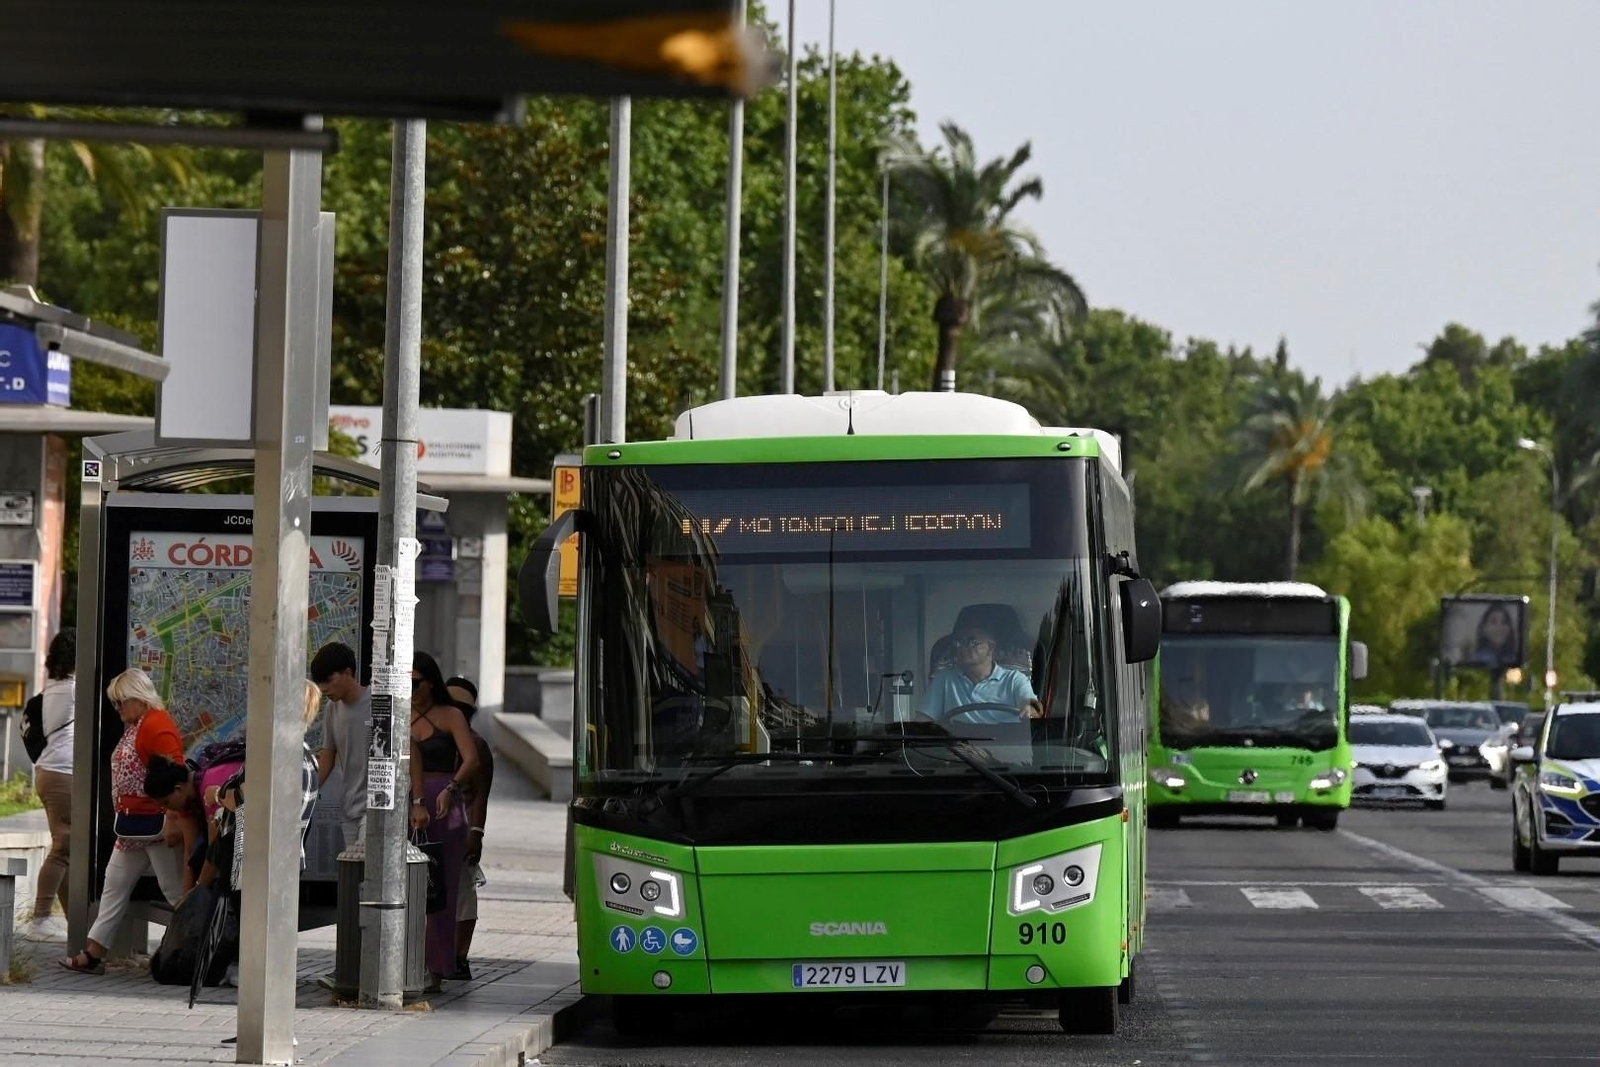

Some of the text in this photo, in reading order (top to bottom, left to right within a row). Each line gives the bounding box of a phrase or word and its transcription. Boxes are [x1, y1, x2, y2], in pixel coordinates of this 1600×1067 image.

[168, 537, 324, 569] CÓRDA
[809, 922, 888, 936] SCANIA
[1018, 922, 1067, 945] 910
[806, 965, 899, 985] 2279 LZV
